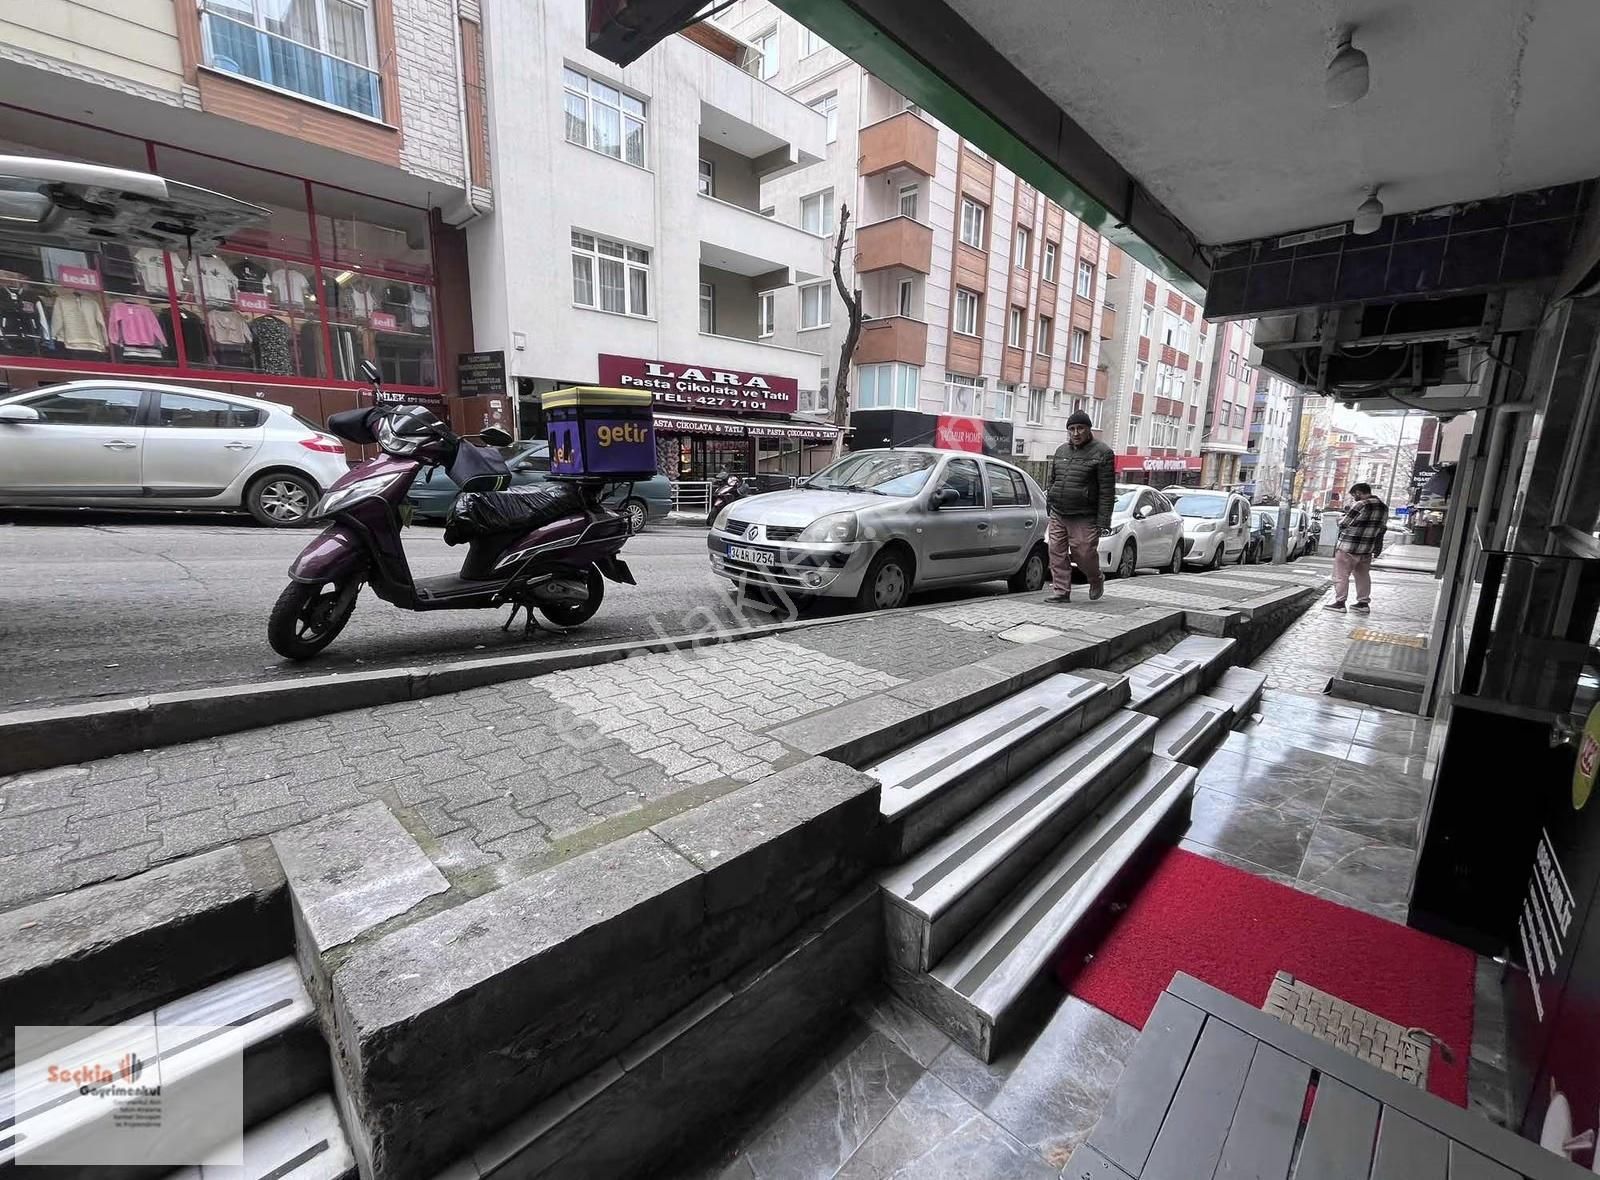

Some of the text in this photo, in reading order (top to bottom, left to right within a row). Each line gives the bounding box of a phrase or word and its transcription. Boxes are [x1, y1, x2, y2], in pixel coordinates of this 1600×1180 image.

[62, 271, 97, 286] tedi
[241, 299, 268, 310] tedi
[374, 318, 395, 328] tedi
[645, 362, 771, 389] LARA
[621, 375, 790, 401] Pasta Çikolata ve Tatlı
[652, 392, 692, 403] TEL:
[696, 396, 726, 406] 427
[653, 419, 674, 428] ASTA
[597, 422, 649, 447] getir
[748, 427, 765, 436] LARA
[767, 428, 785, 437] PASTA
[732, 547, 773, 565] 34 AR 1254
